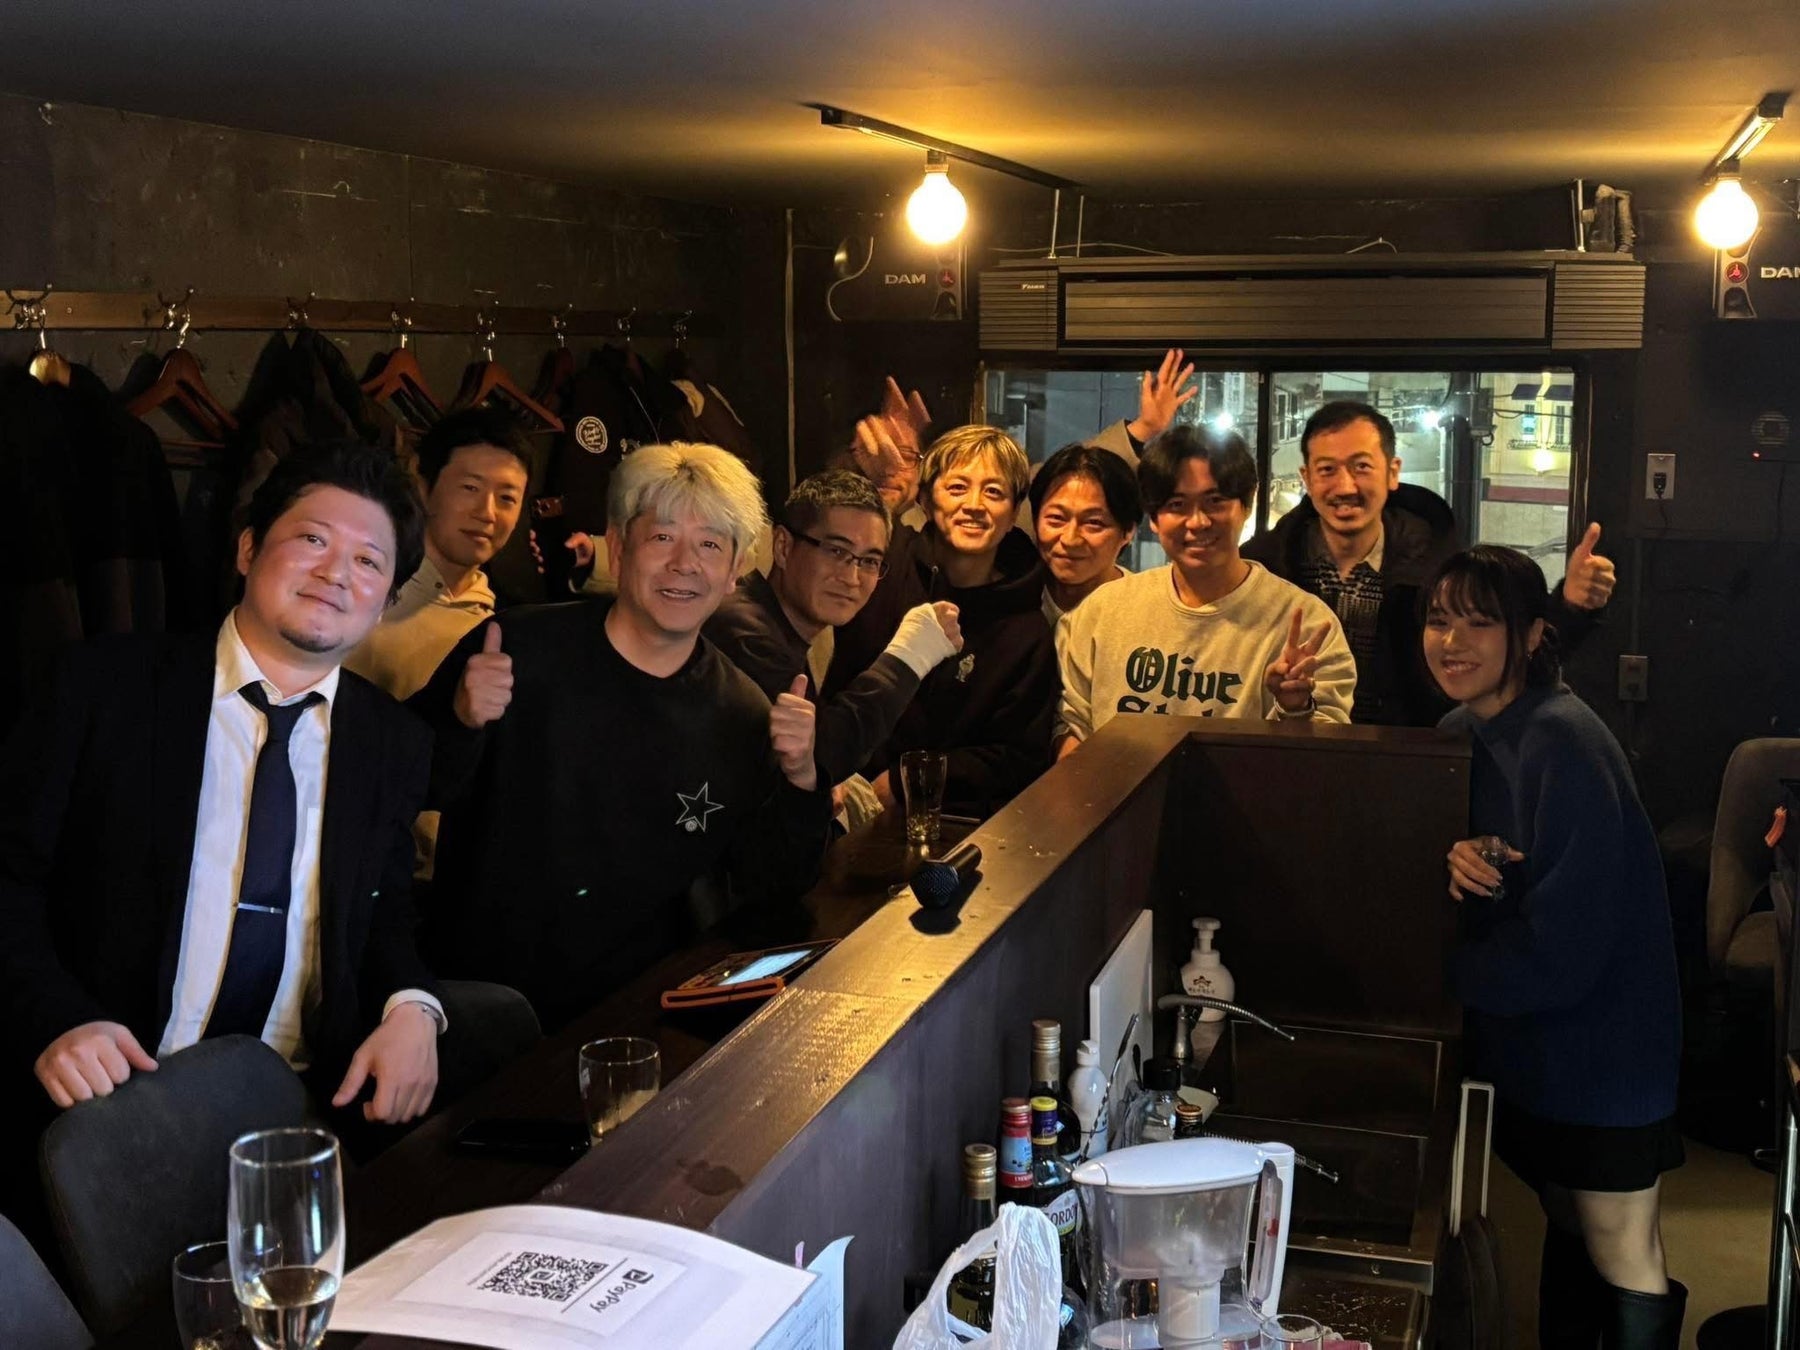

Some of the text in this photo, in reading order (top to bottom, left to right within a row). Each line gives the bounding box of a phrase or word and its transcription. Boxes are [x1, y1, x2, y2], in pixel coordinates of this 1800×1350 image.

[884, 273, 927, 285] DAM
[1125, 646, 1243, 704] Olive
[589, 1281, 637, 1313] PayPay
